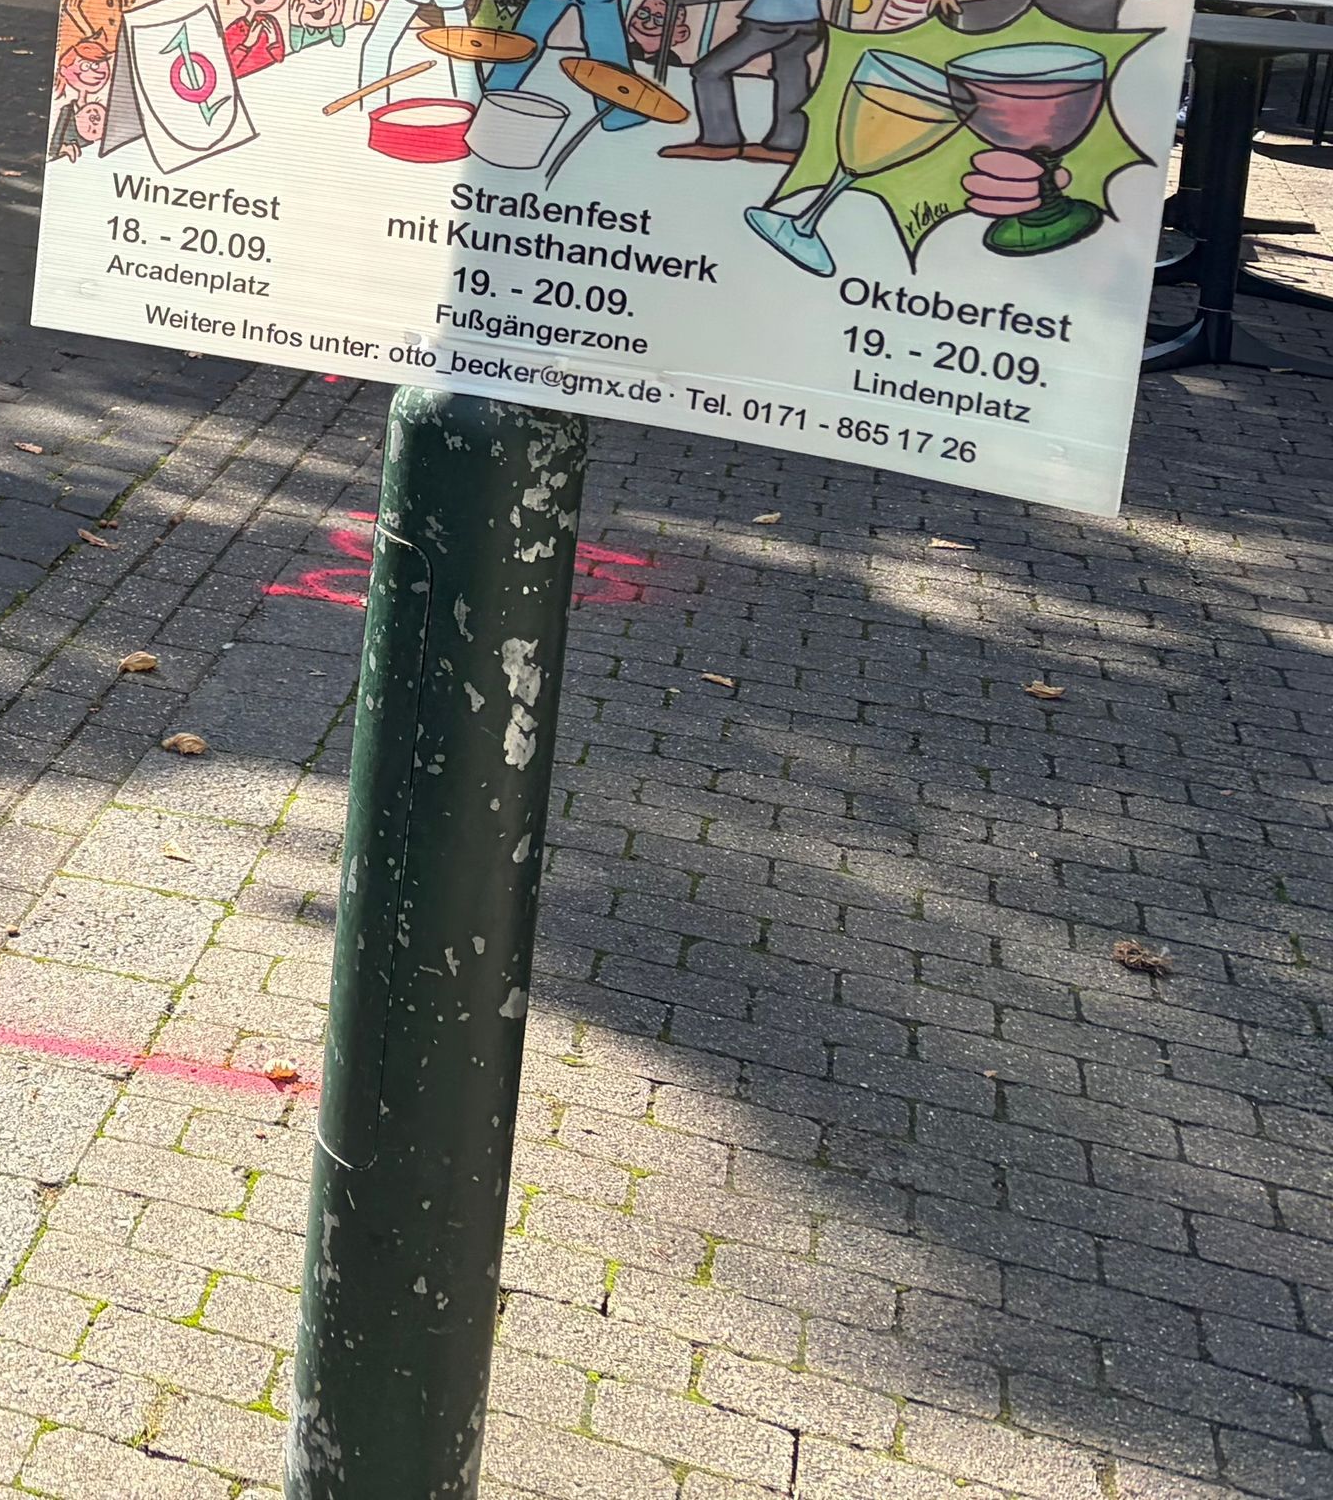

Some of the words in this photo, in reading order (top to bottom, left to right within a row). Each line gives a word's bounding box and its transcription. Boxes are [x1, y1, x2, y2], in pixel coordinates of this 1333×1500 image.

[114, 173, 280, 221] Winzerfest
[451, 184, 652, 236] Straßenfest
[108, 217, 147, 245] 18.
[181, 227, 272, 263] 20.09.
[388, 216, 439, 245] mit
[447, 221, 718, 284] Kunsthandwerk
[107, 256, 270, 297] Arcadenplatz
[453, 267, 498, 298] 19.
[533, 279, 634, 317] 20.09.
[437, 304, 648, 354] Fußgängerzone
[840, 278, 1072, 342] Oktoberfest
[844, 326, 893, 359] 19.
[934, 342, 1047, 388] 20.09.
[146, 304, 236, 337] Weitere
[244, 320, 303, 348] Infos
[310, 334, 379, 358] unter:
[390, 346, 662, 403] otto_becker@gmx.de
[687, 388, 732, 416] Tel.
[743, 399, 806, 431] 0171
[837, 417, 890, 446] 865
[899, 429, 934, 454] 17
[941, 437, 977, 463] 26
[854, 370, 1031, 423] Lindenplatz
